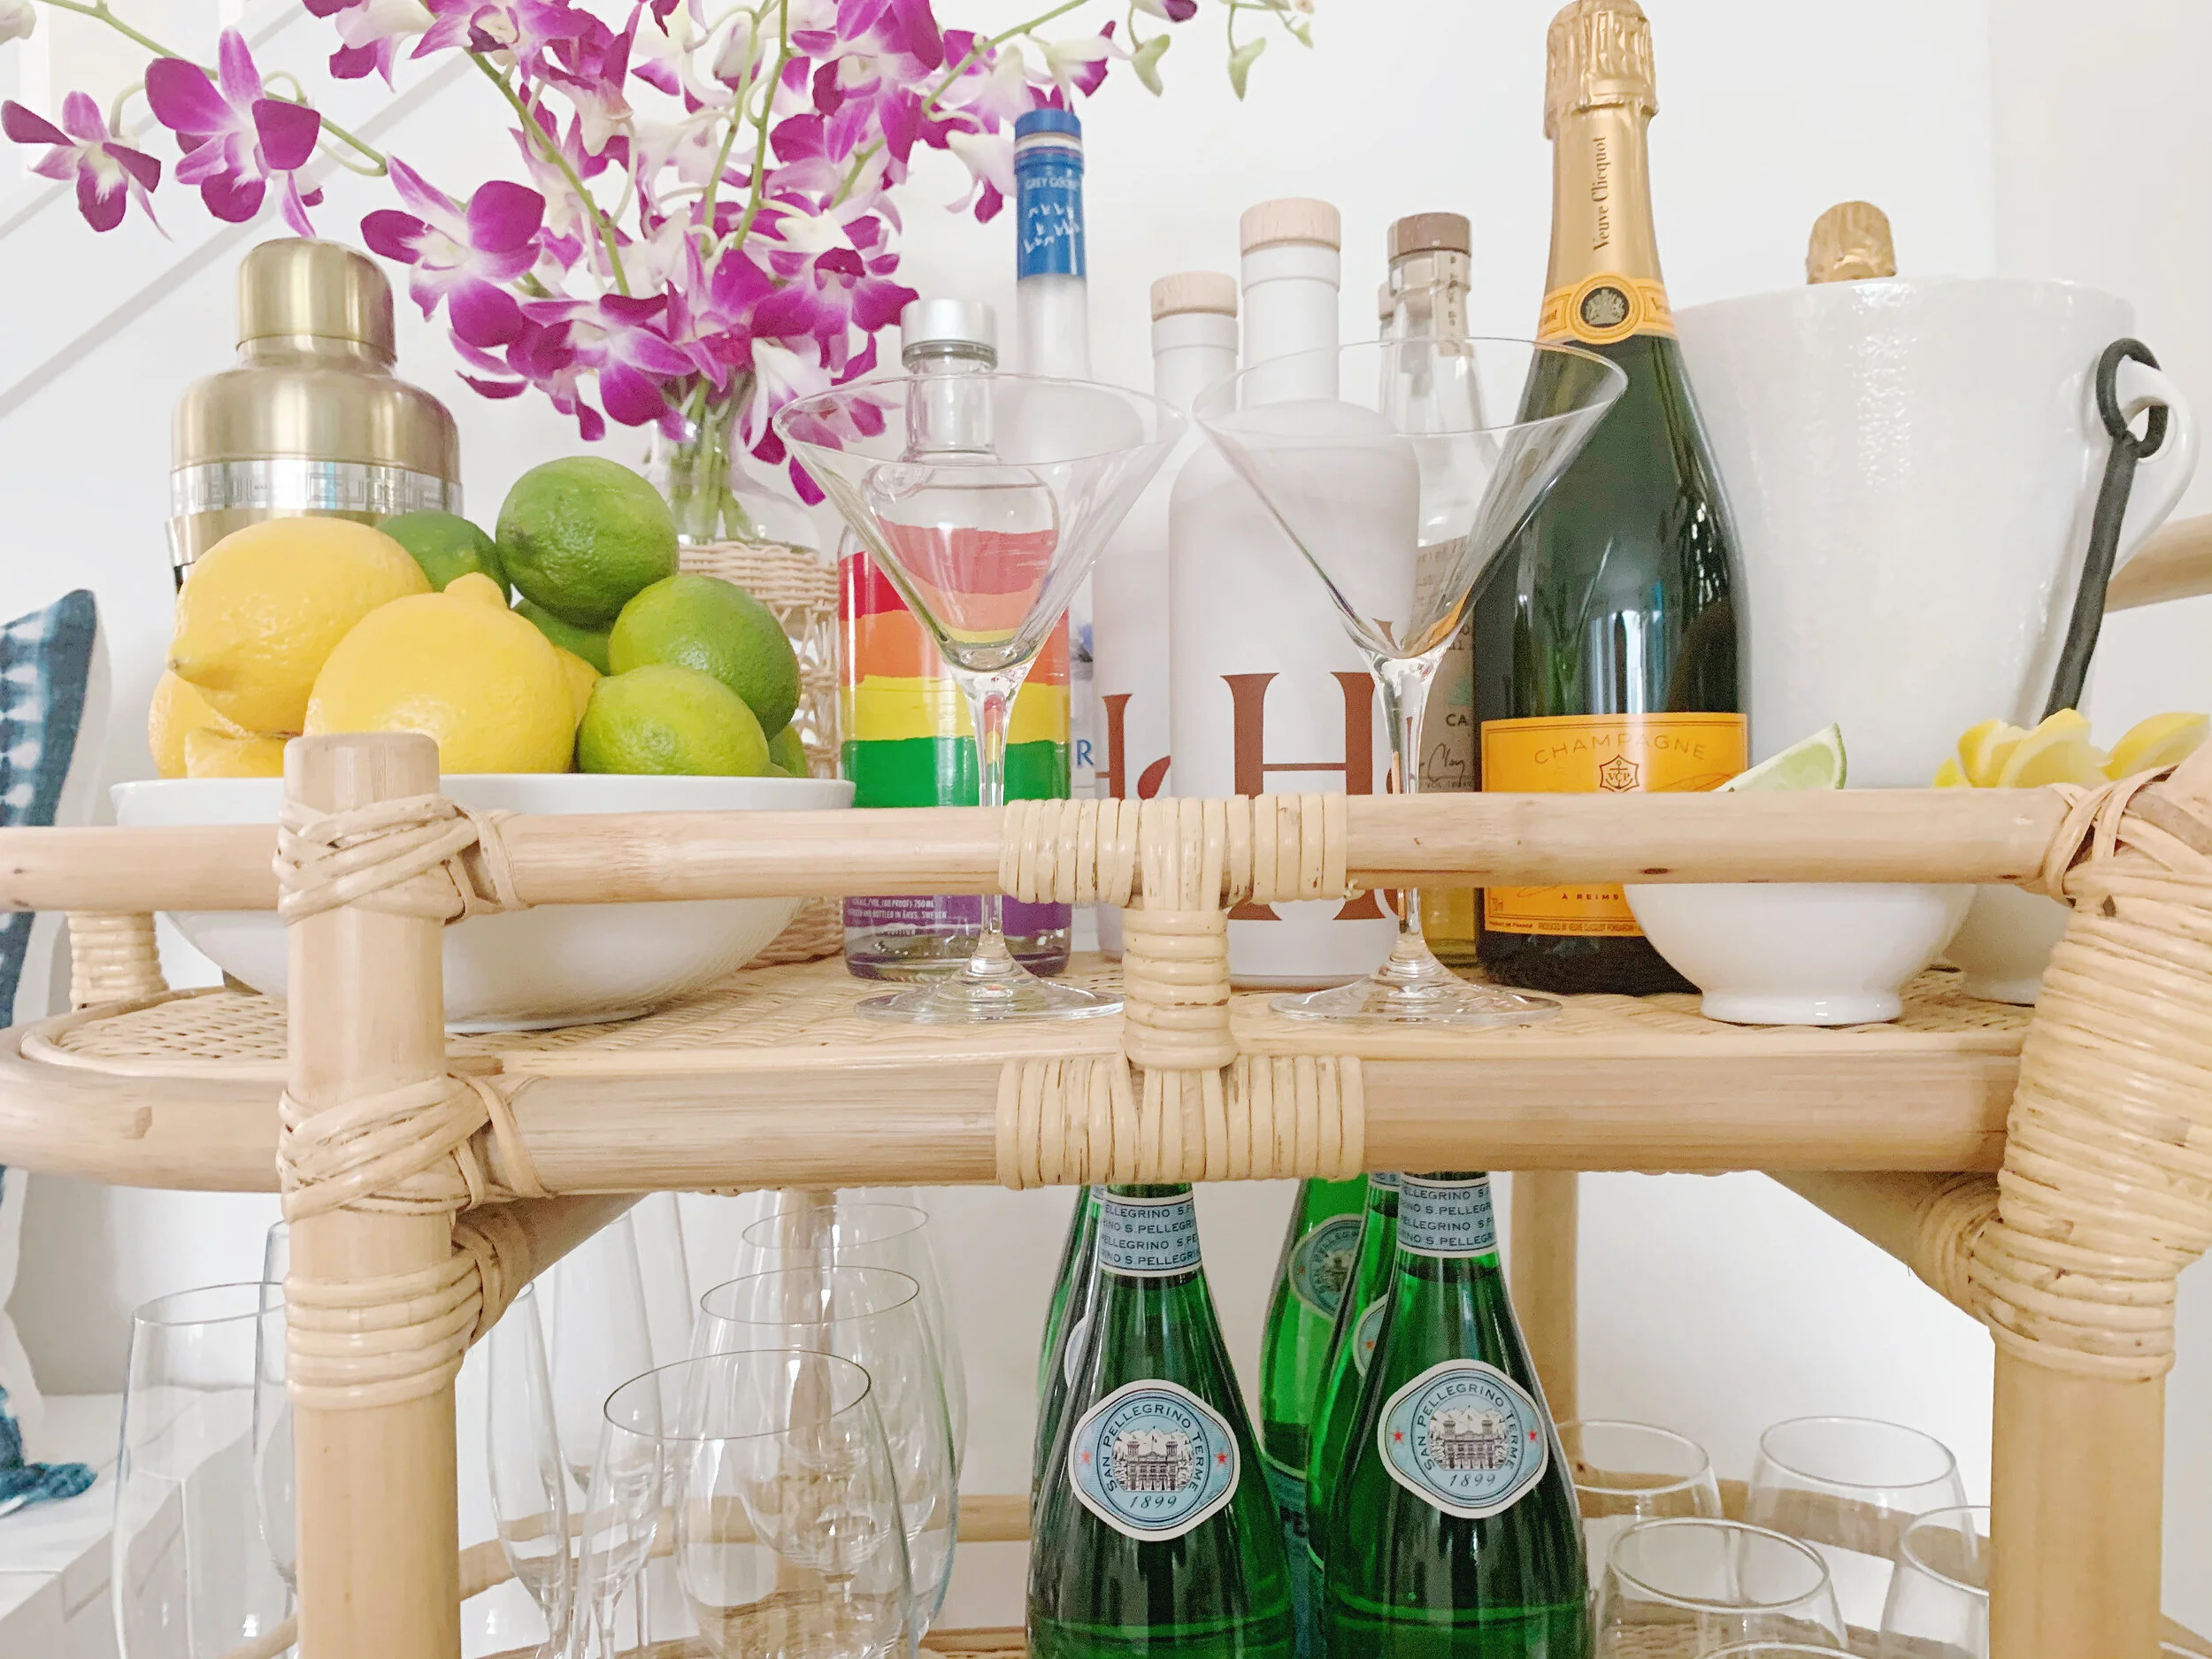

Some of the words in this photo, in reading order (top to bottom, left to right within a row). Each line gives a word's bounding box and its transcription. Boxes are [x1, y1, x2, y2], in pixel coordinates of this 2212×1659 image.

[1591, 136, 1611, 203] Clicquot
[1593, 205, 1610, 251] Veuve
[1534, 733, 1707, 764] CHAMPAGNE
[1102, 1403, 1191, 1448] PELLEGRINO
[1417, 1383, 1505, 1427] PELLEGRINO
[1191, 1431, 1204, 1493] TERME
[1417, 1435, 1435, 1471] SAN
[1505, 1410, 1518, 1470] TERME
[1103, 1456, 1118, 1492] SAN
[1449, 1473, 1496, 1487] 1899
[1129, 1494, 1178, 1509] 1899
